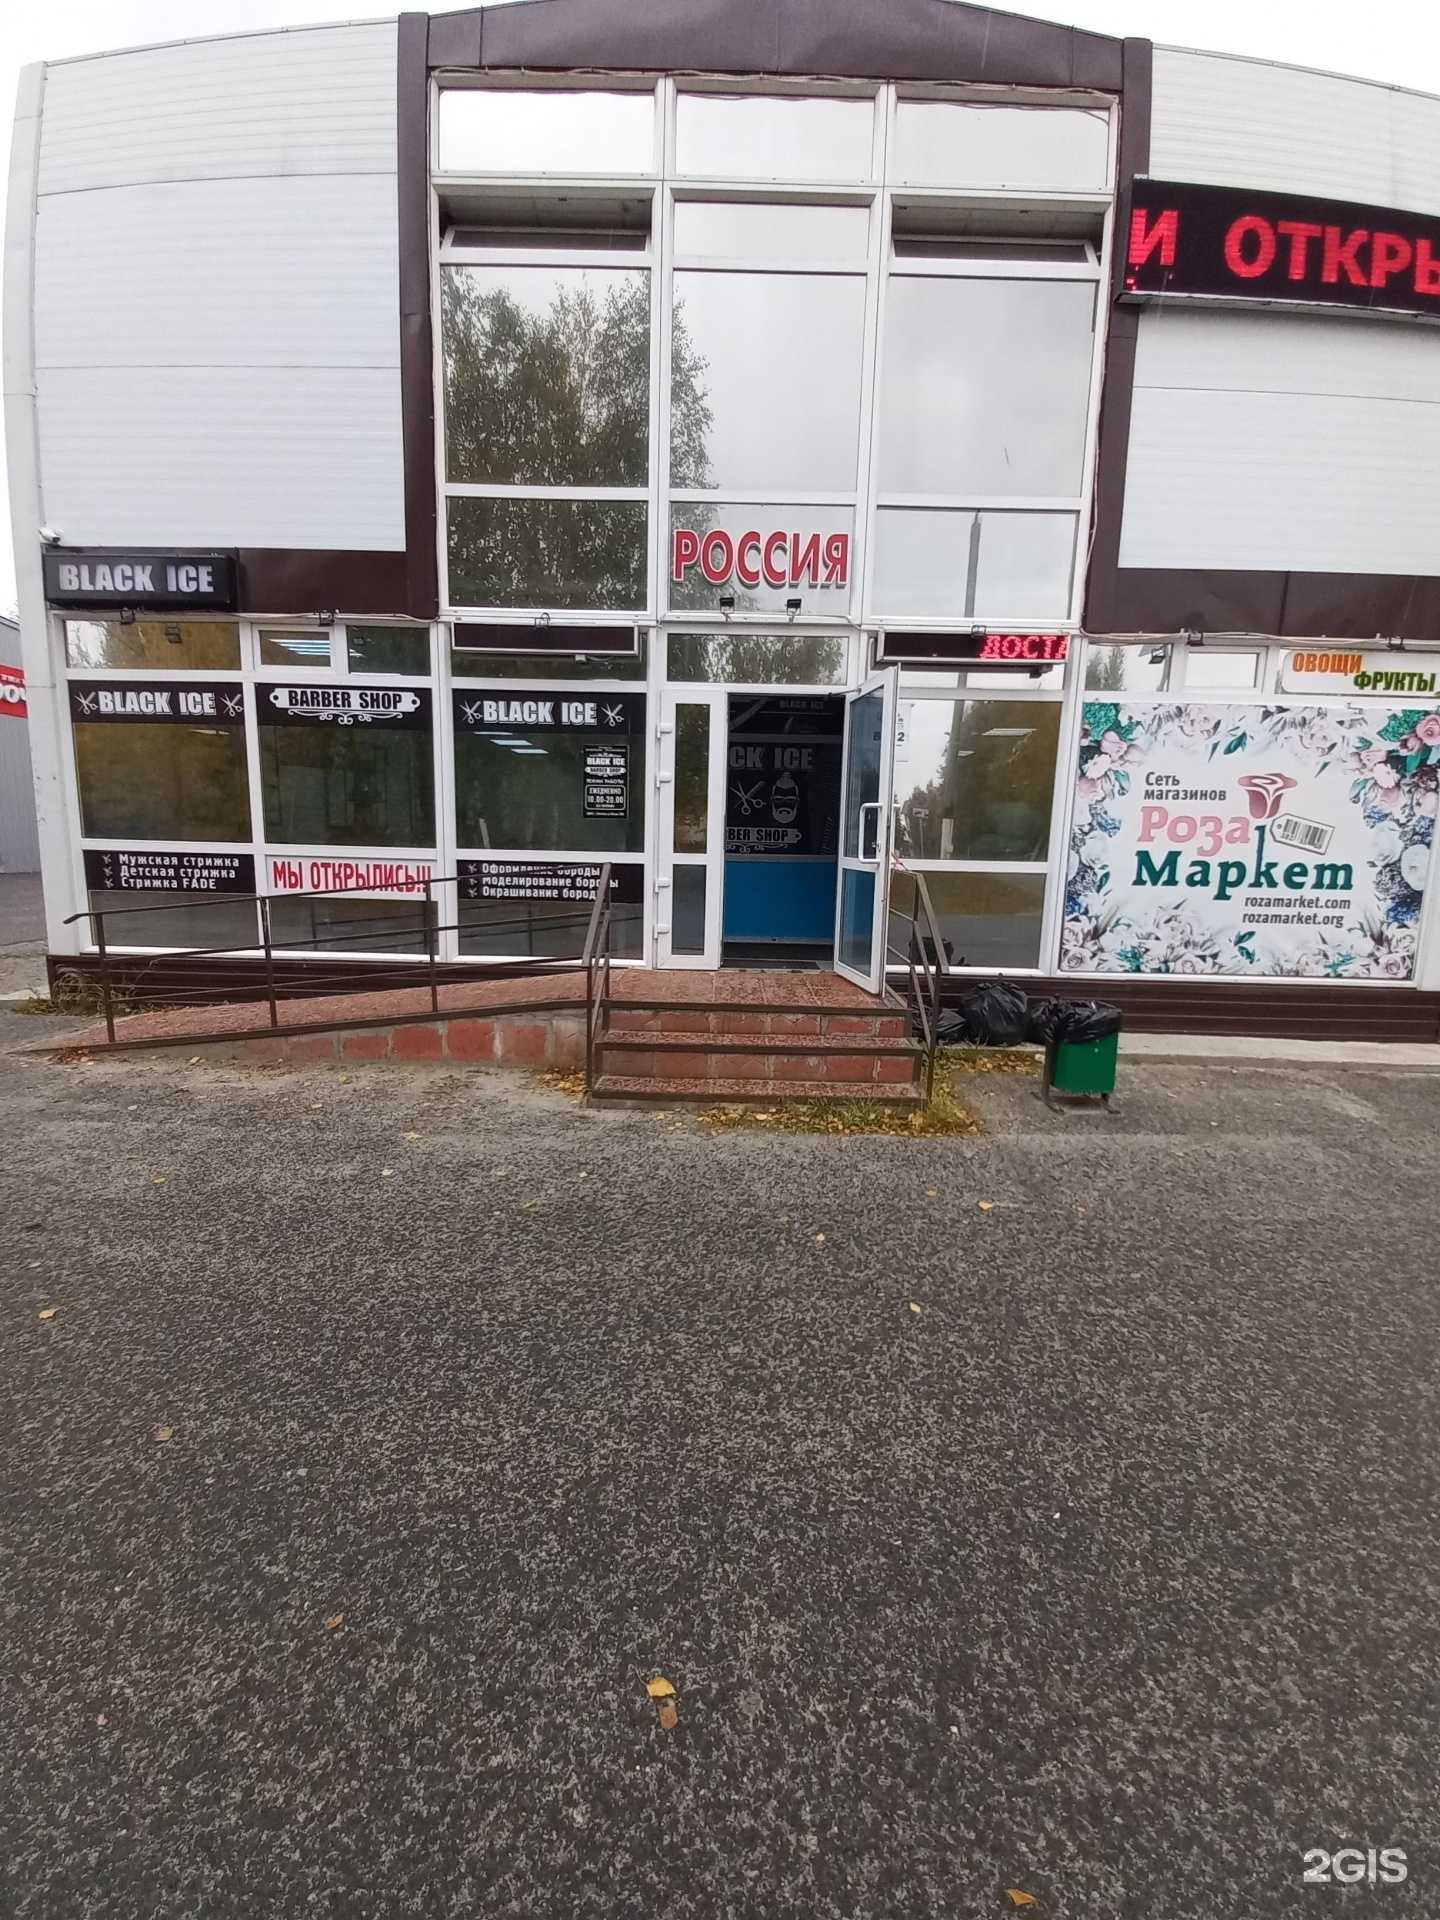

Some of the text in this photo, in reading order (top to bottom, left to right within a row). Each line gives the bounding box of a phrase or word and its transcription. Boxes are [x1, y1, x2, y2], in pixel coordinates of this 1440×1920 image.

[1128, 208, 1179, 266] И
[673, 528, 850, 585] РОССИЯ
[58, 564, 214, 593] BLACK ICE
[1292, 652, 1363, 676] ОВОЩИ
[1353, 671, 1437, 692] ФРУКТЫ
[98, 690, 217, 716] BLACK ICE
[287, 689, 403, 710] BARBER SHOP
[483, 700, 598, 726] BLACK ICE
[774, 748, 813, 769] ICE
[1145, 771, 1180, 787] Сеть
[1143, 788, 1227, 801] магазинов
[756, 830, 789, 842] SHOP
[1136, 805, 1251, 857] Роза
[119, 854, 240, 868] Мужская стрижка
[1131, 825, 1354, 901] Маркет
[120, 866, 236, 878] Детская стрижка
[273, 861, 304, 889] МЫ
[121, 877, 217, 889] Стрижка FADE
[482, 886, 597, 900] Окрашивание бород
[576, 877, 619, 889] бороы
[1244, 896, 1351, 909] rozamarket.com
[1242, 912, 1344, 928] rozamarket.org
